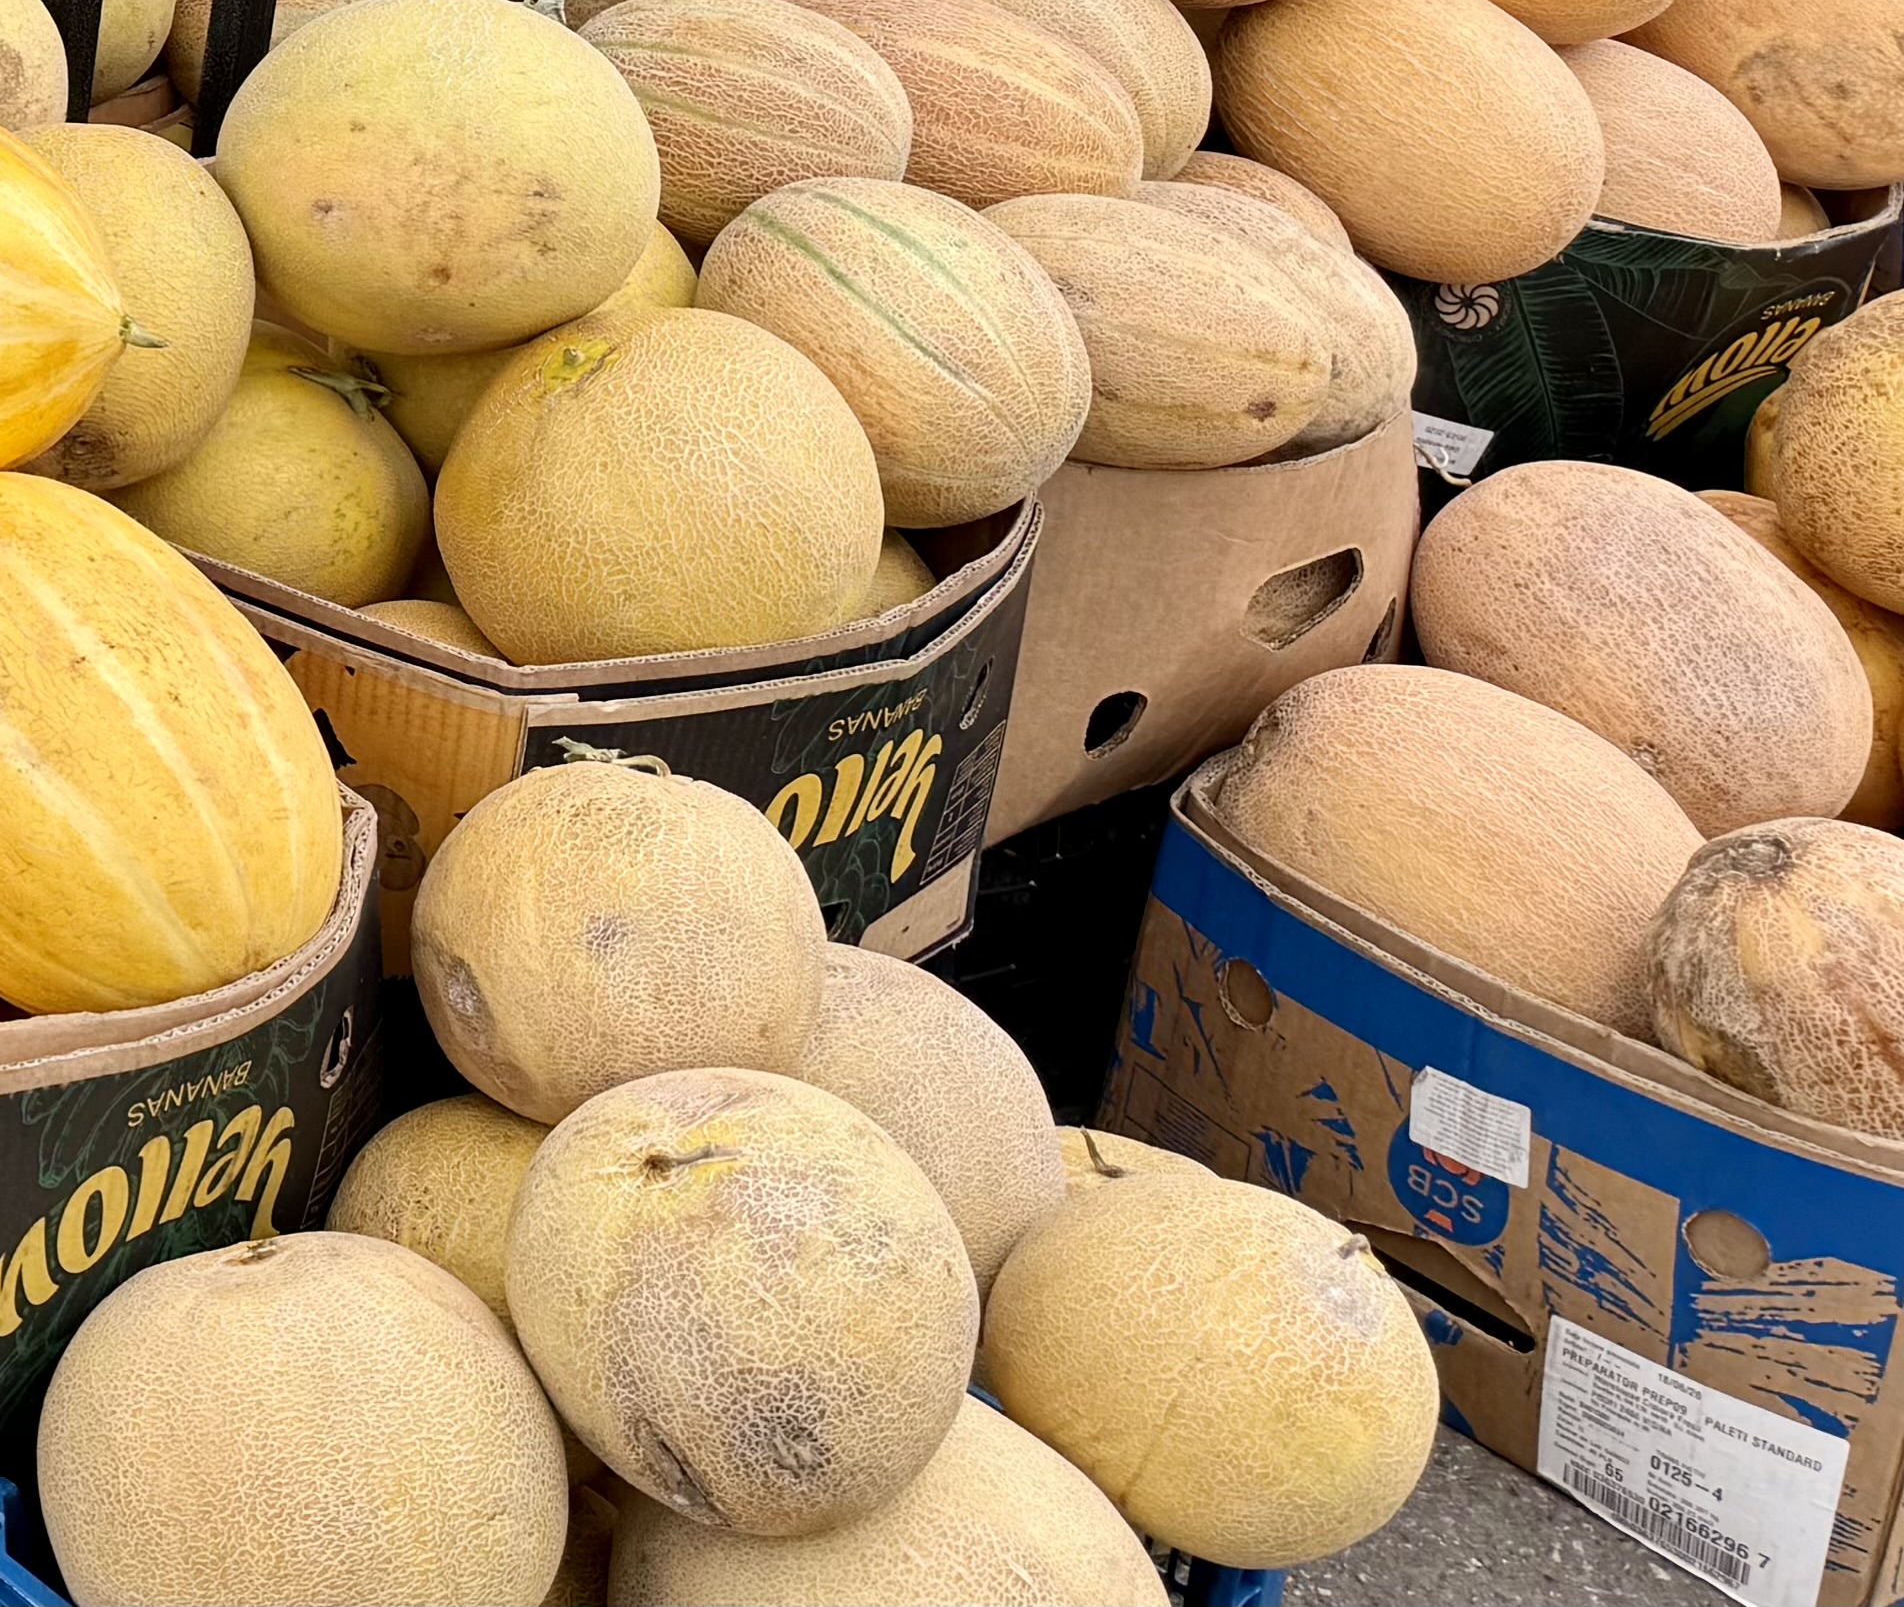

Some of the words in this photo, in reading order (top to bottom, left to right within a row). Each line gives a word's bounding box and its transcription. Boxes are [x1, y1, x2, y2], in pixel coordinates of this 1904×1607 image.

[828, 688, 928, 741] BANANAS
[127, 1059, 252, 1128] BANANAS
[1407, 1164, 1484, 1224] SCB
[1752, 1436, 1823, 1472] STANDARD
